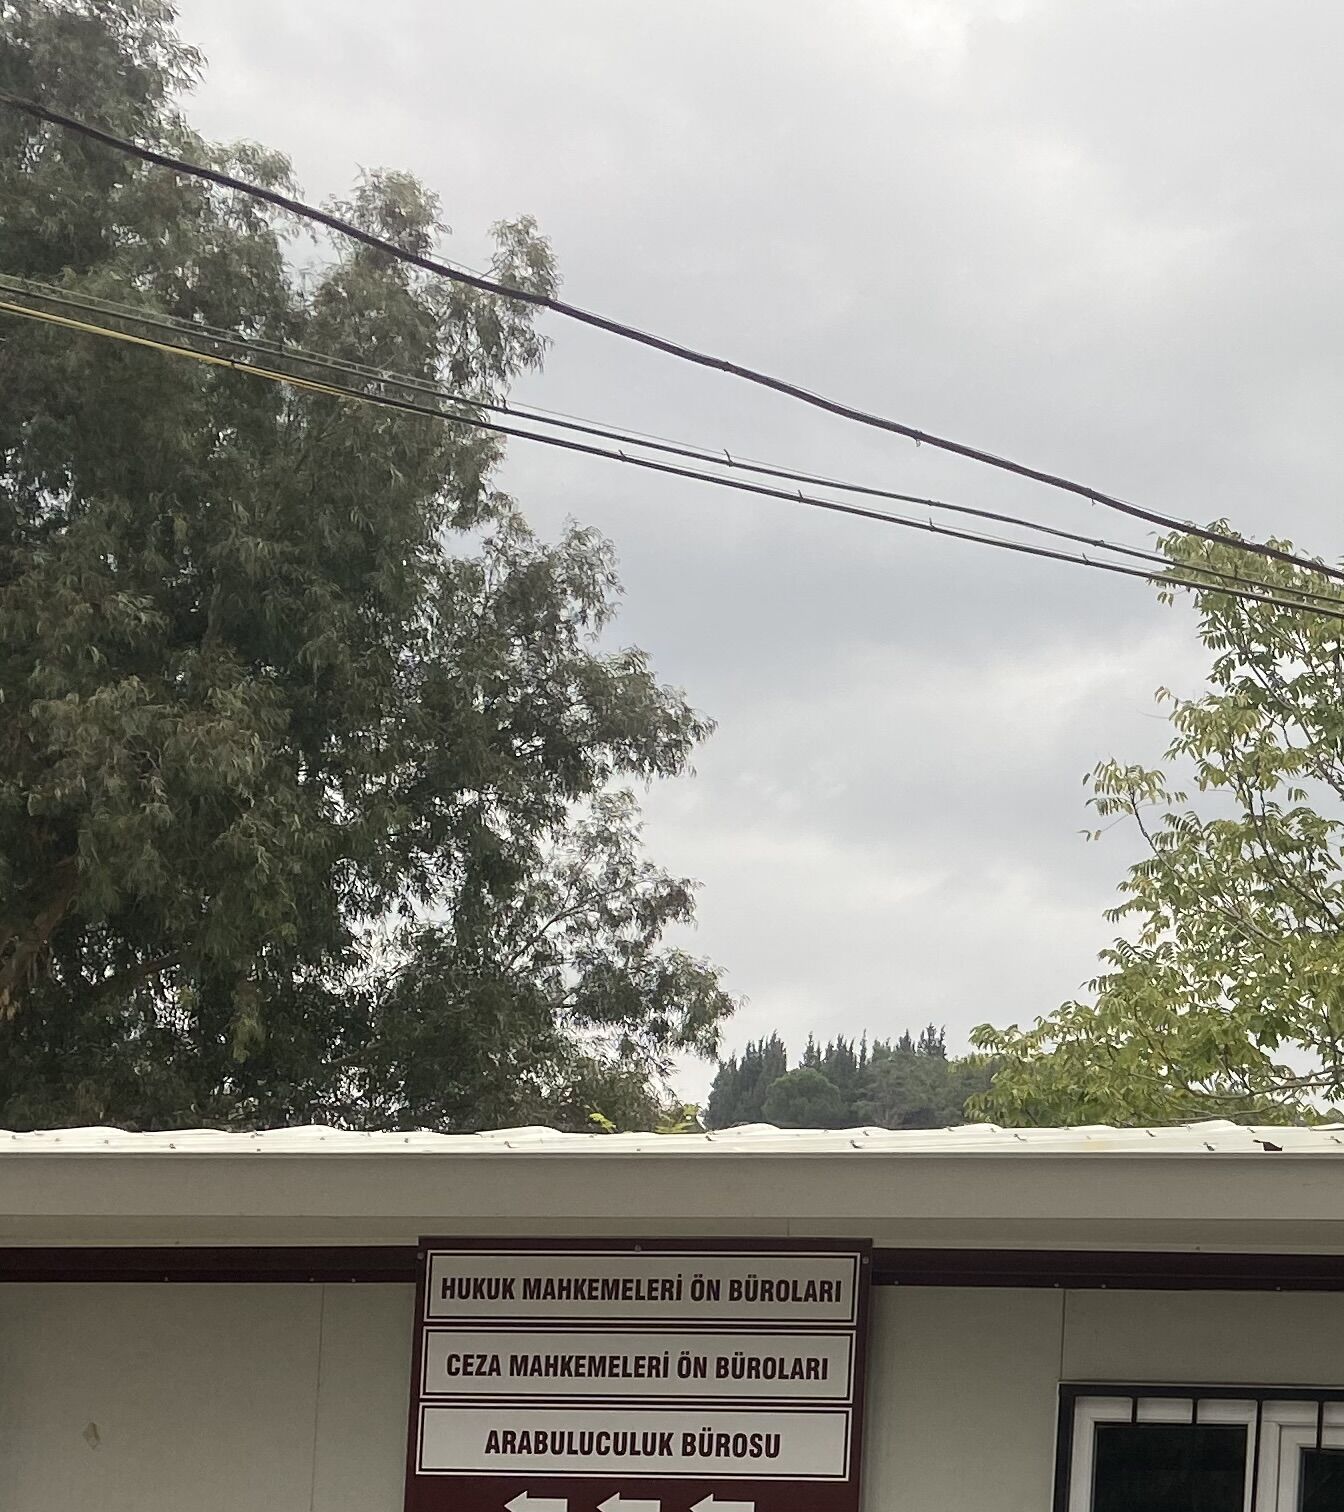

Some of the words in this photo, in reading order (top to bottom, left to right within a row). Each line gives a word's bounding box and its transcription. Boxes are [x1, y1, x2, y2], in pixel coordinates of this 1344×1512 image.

[441, 1277, 516, 1301] HUKUK
[521, 1273, 683, 1303] MAHKEMELERİ
[690, 1273, 721, 1302] ÖN
[728, 1273, 843, 1303] BÜROLARI
[446, 1353, 502, 1378] CEZA
[509, 1350, 670, 1379] MAHKEMELERİ
[677, 1350, 708, 1379] ÖN
[715, 1351, 829, 1381] BÜROLARI
[484, 1429, 675, 1457] ARABULUCULUK
[681, 1427, 782, 1459] BÜROSU
